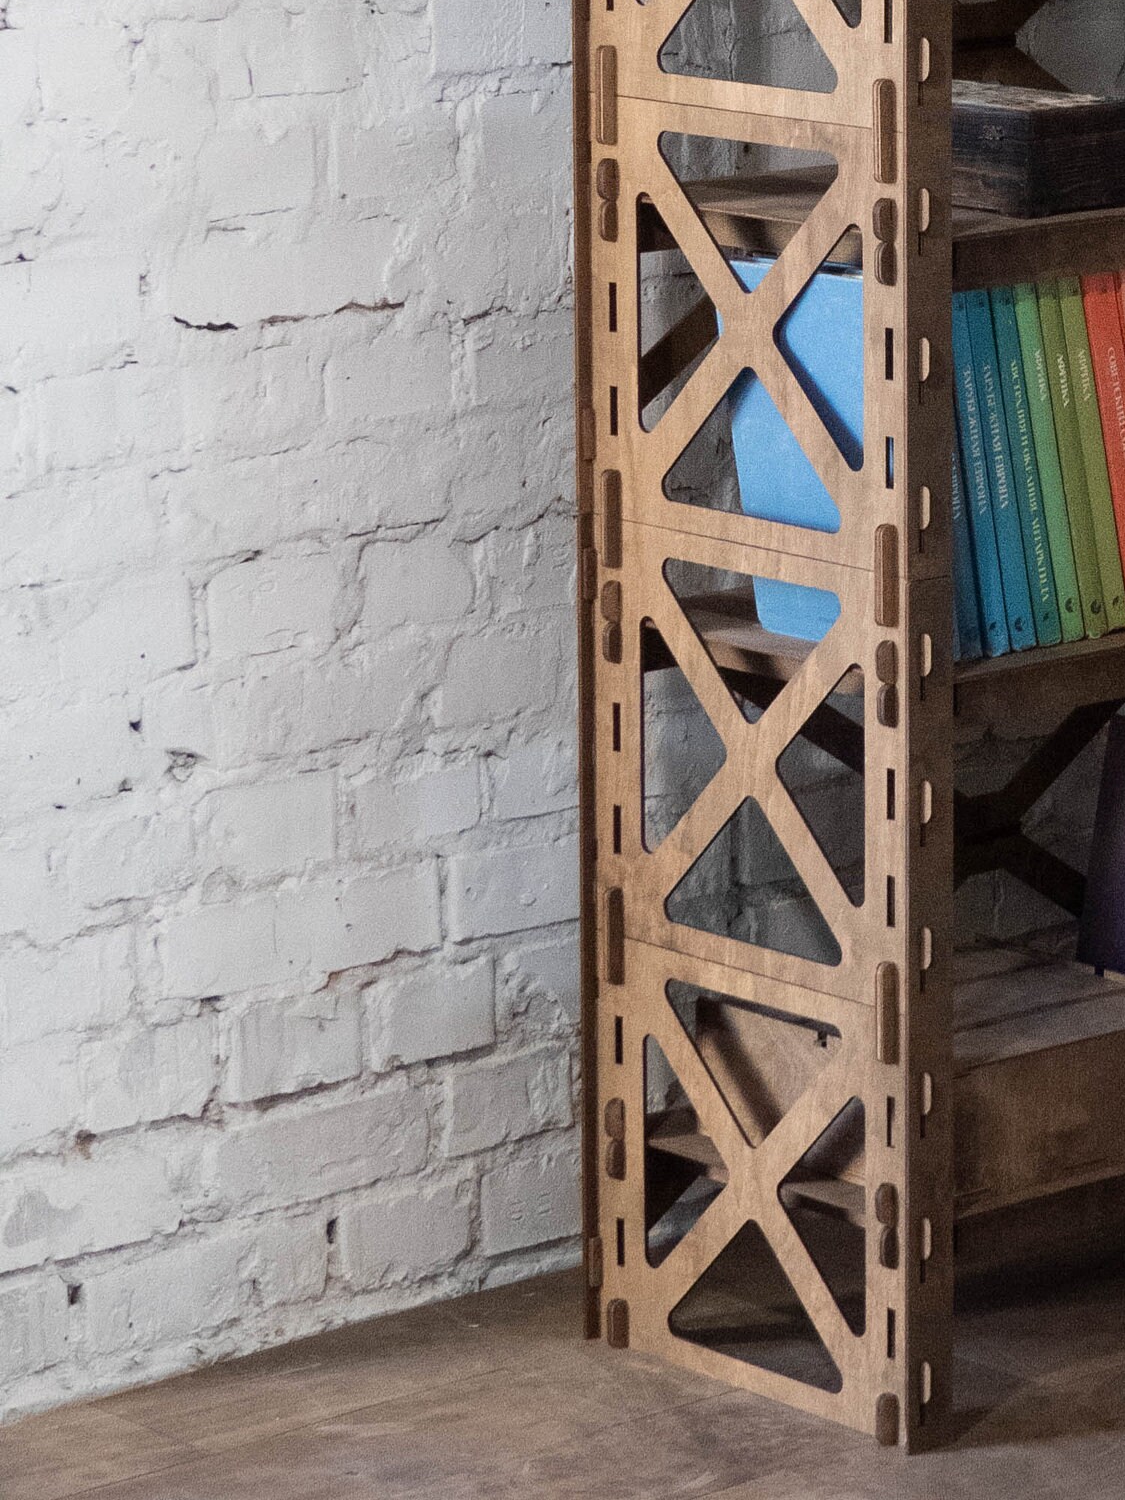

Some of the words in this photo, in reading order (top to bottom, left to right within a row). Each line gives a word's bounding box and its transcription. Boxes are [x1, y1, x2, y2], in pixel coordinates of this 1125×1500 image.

[1034, 348, 1048, 402] АФРИКА
[1055, 353, 1070, 408] АФРИКА
[1077, 349, 1092, 402] АФРИКА
[1107, 346, 1125, 427] СОВЕТСКИЙ
[962, 364, 981, 458] ЗАРУБЕЖНАЯ
[973, 461, 988, 516] ЕВРОПА
[982, 362, 1002, 453] ЗАРУБЕЖНАЯ
[993, 456, 1010, 510] ЕВРОПА
[1010, 358, 1028, 432] АВСТРАЛИЯ
[1030, 517, 1050, 603] АНТАРКТИДА
